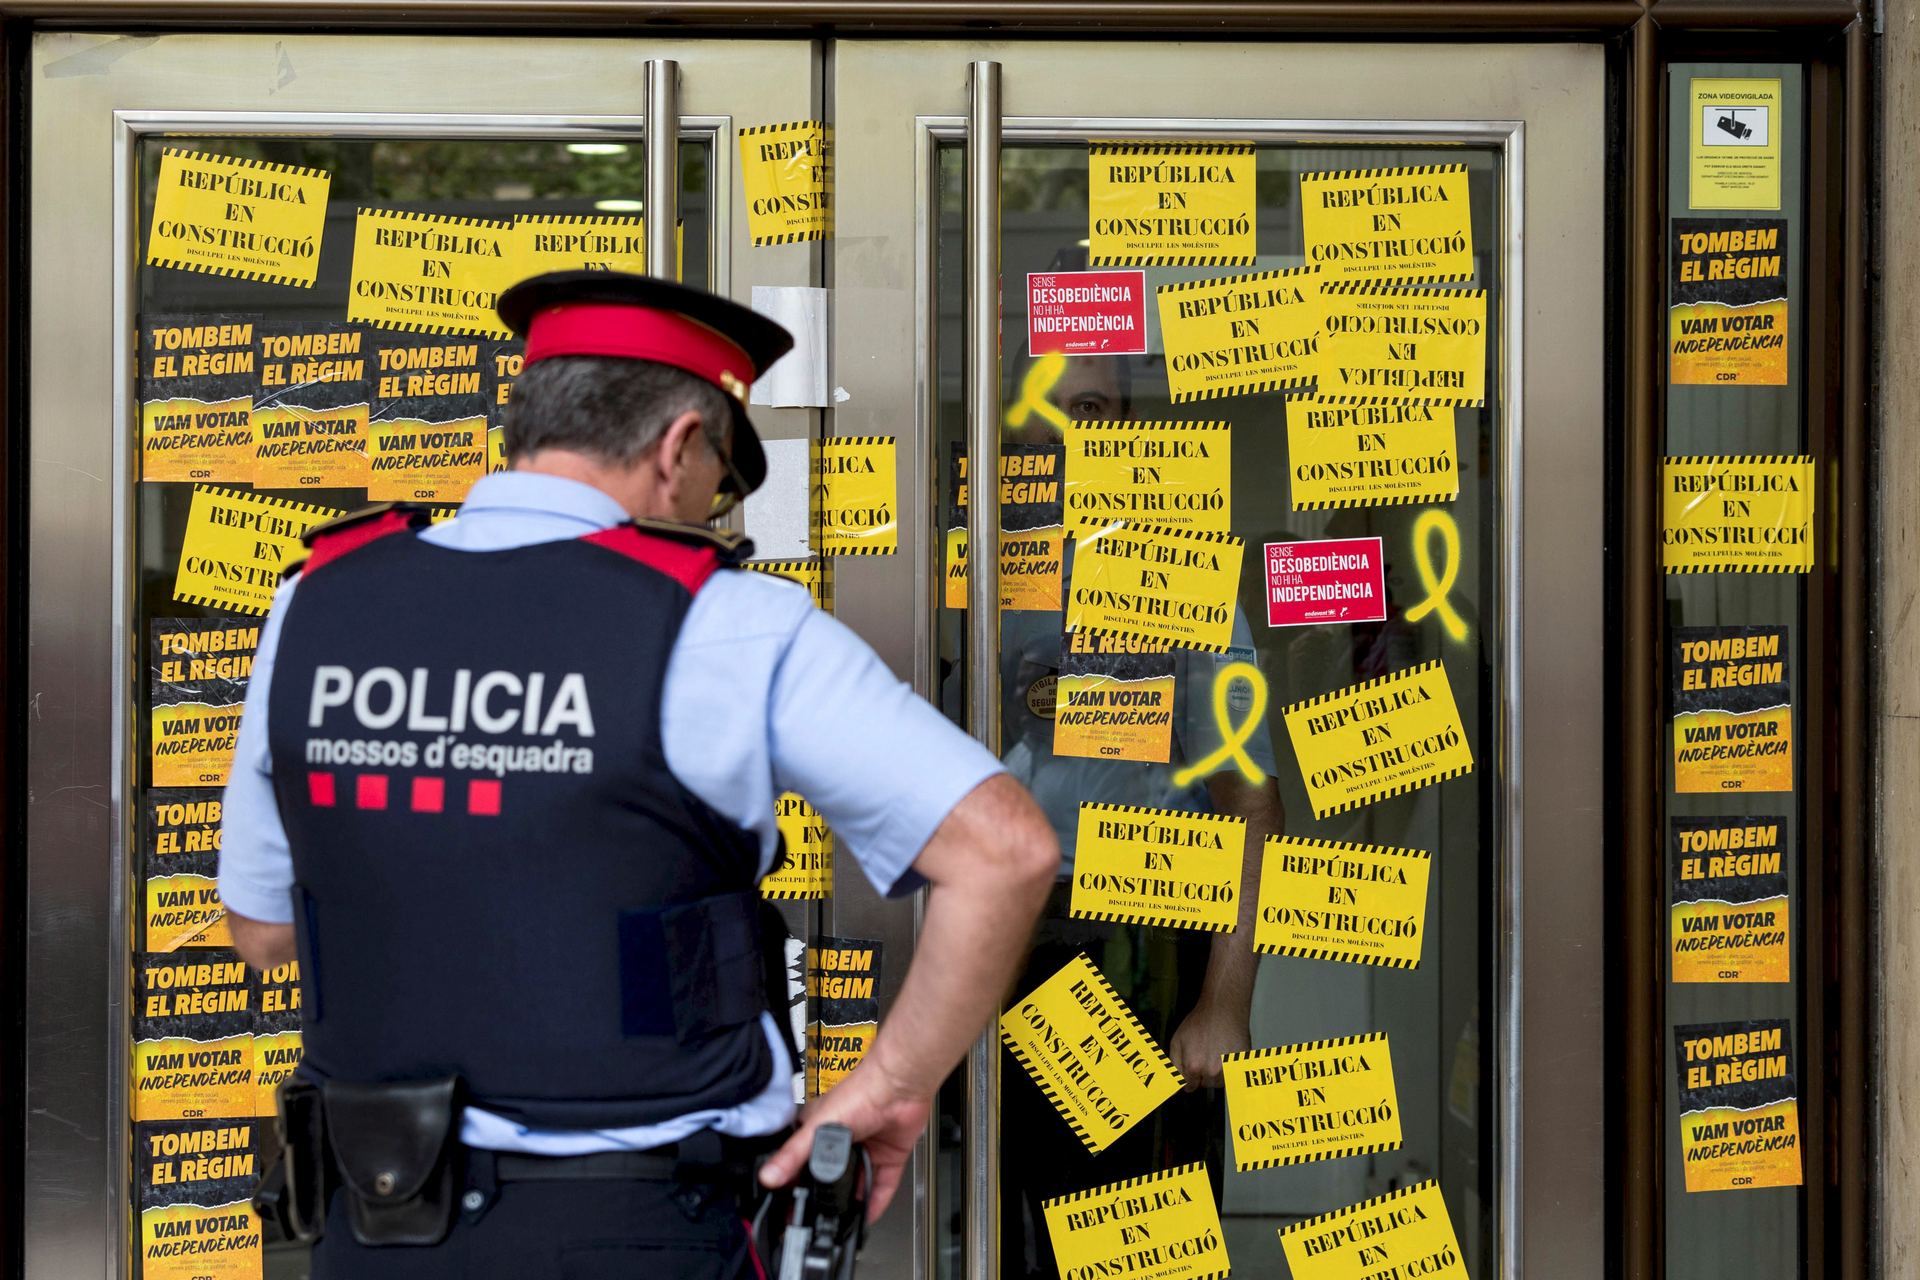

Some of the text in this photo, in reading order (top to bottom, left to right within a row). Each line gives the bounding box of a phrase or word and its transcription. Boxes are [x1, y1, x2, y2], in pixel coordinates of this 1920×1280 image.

[1109, 160, 1235, 183] REPÚBLICA
[178, 168, 306, 205] REPÚBLICA
[1321, 182, 1448, 208] REPÚBLICA
[225, 202, 255, 223] EN
[1158, 192, 1186, 210] EN
[1095, 212, 1249, 236] CONSTRUCCIÓ
[1372, 213, 1401, 232] EN
[157, 220, 313, 258] CONSTRUCCIÓ
[375, 227, 502, 257] REPÚBLICA
[1311, 230, 1465, 261] CONSTRUCCIÓ
[1679, 227, 1778, 255] TOMBEM
[186, 248, 282, 267] DISCULPEU LES MOLÈSTIES
[422, 259, 451, 278] EN
[1680, 252, 1780, 282] EL RÈGIM
[1032, 276, 1056, 288] SENSE
[1033, 284, 1131, 304] DESOBEDIÈNCIA
[356, 280, 497, 311] CONSTRUCCI
[1178, 287, 1305, 319] REPÚBLICA
[1033, 304, 1065, 316] NO HI HA
[1033, 312, 1135, 333] INDEPENDÈNCIA
[1230, 318, 1259, 338] EN
[1325, 314, 1480, 338] CONSTRUCCIÓ
[1680, 314, 1774, 335] VAM VOTAR
[152, 323, 253, 350] TOMBEM
[260, 332, 361, 358] TOMBEM
[1673, 332, 1783, 354] INDEPENDÈNCIA
[153, 348, 253, 378] EL RÈGIM
[378, 345, 477, 370] TOMBEM
[1172, 330, 1320, 372] CONSTRUCCIÓ
[1387, 342, 1416, 360] EN
[262, 356, 363, 385] EL RÈGIM
[1338, 367, 1464, 392] REPÚBLICA
[1715, 372, 1737, 381] CDR
[378, 375, 403, 398] EL
[406, 369, 480, 396] RÈGIM
[153, 410, 249, 431] VAM VOTAR
[1306, 402, 1433, 429] REPÚBLICA
[262, 418, 357, 439] VAM VOTAR
[377, 430, 473, 451] VAM VOTAR
[255, 436, 366, 458] INDEPENDÈNCIA
[1083, 434, 1209, 458] REPÚBLICA
[1357, 433, 1386, 452] EN
[370, 449, 482, 471] INDEPENDÈNCIA
[1296, 449, 1450, 481] CONSTRUCCIÓ
[1132, 466, 1160, 484] EN
[1672, 470, 1799, 492] REPÚBLICA
[413, 490, 435, 499] CDR
[1069, 487, 1224, 510] CONSTRUCCIÓ
[1722, 500, 1751, 518] EN
[253, 541, 284, 562] EN
[1094, 536, 1219, 572] REPÚBLICA
[1270, 546, 1294, 558] SENSE
[1270, 552, 1370, 574] DESOBEDIÈNCIA
[1140, 570, 1170, 590] EN
[1271, 574, 1303, 586] NO HI HA
[1272, 580, 1373, 603] INDEPENDÈNCIA
[1074, 588, 1227, 624] CONSTRUCCIÓ
[159, 627, 258, 655] TOMBEM
[1070, 634, 1095, 654] EL
[1680, 634, 1778, 663] TOMBEM
[161, 660, 185, 683] EL
[1682, 660, 1782, 690] EL RÈGIM
[1031, 677, 1058, 694] VIGILA
[308, 665, 596, 737] POLICIA
[1067, 690, 1162, 706] VAM VOTAR
[1058, 707, 1171, 725] INDEPENDÈNCIA
[1306, 685, 1431, 736] REPÚBLICA
[162, 718, 199, 736] VAM
[1361, 722, 1392, 747] EN
[1683, 720, 1778, 743] VAM VOTAR
[305, 737, 418, 767] mossos
[1310, 724, 1459, 789] CONSTRUCCIÓ
[1677, 739, 1788, 763] INDEPENDÈNCIA
[1344, 761, 1436, 793] DISCULPEU LES MOLÈSTIES
[156, 832, 181, 855] EL
[1097, 820, 1223, 850] REPÚBLICA
[1679, 824, 1777, 852] TOMBEM
[1144, 851, 1173, 870] EN
[1281, 854, 1407, 885] REPÚBLICA
[1680, 850, 1780, 880] EL RÈGIM
[157, 890, 195, 908] VAM
[1079, 872, 1233, 902] CONSTRUCCIÓ
[1327, 886, 1357, 905] EN
[1262, 906, 1417, 938] CONSTRUCCIÓ
[1681, 911, 1775, 933] VAM VOTAR
[1674, 929, 1785, 952] INDEPENDÈNCIA
[145, 961, 245, 989] TOMBEM
[146, 987, 248, 1017] EL RÈGIM
[261, 989, 286, 1013] EL
[1069, 978, 1155, 1088] REPÚBLICA
[1683, 1028, 1781, 1061] TOMBEM
[145, 1049, 242, 1071] VAM VOTAR
[1078, 1034, 1108, 1065] EN
[1021, 1003, 1129, 1130] CONSTRUCCIÓ
[1028, 1039, 1090, 1117] DISCULPEU LES MOLÈSTIES
[1243, 1055, 1371, 1088] REPÚBLICA
[1687, 1055, 1786, 1089] EL RÈGIM
[138, 1068, 252, 1091] INDEPENDÈNCIA
[1296, 1086, 1326, 1107] EN
[1237, 1098, 1391, 1142] CONSTRUCCIÓ
[1691, 1114, 1785, 1142] VAM VOTAR
[150, 1126, 250, 1157] TOMBEM
[1686, 1133, 1796, 1162] INDEPENDÈNCIA
[152, 1153, 253, 1185] EL RÈGIM
[1067, 1187, 1192, 1231] REPÚBLICA
[153, 1213, 249, 1237] VAM VOTAR
[1120, 1222, 1150, 1245] EN
[1303, 1204, 1429, 1257] REPÚBLICA
[147, 1232, 259, 1257] INDEPENDÈNCIA
[1066, 1228, 1218, 1280] CONSTRUCCIÓ
[1358, 1243, 1389, 1267] EN
